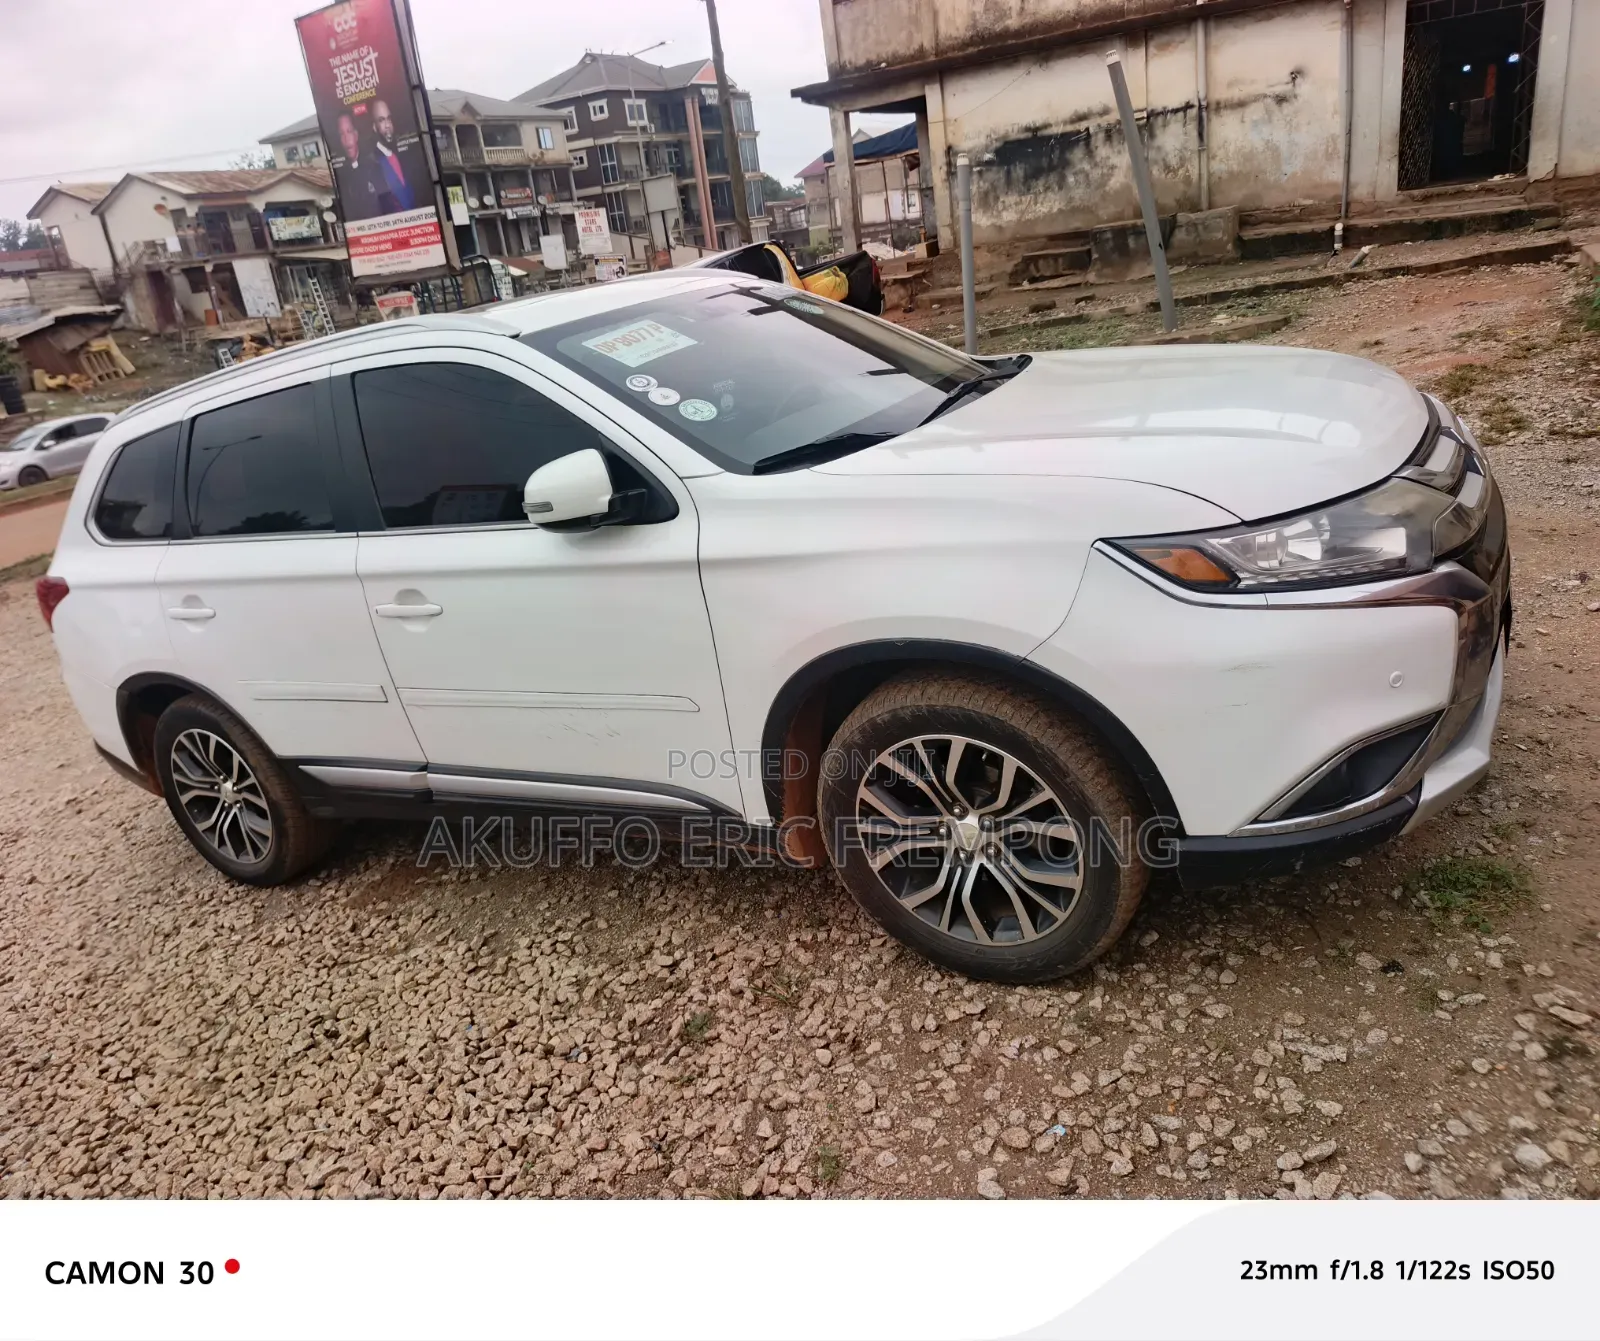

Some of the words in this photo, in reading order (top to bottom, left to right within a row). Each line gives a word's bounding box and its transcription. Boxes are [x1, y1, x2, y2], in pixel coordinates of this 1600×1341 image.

[328, 55, 342, 67] THE
[341, 49, 360, 64] NAME
[359, 45, 369, 57] OF
[335, 86, 344, 98] IS
[343, 75, 377, 96] ENOUGH
[343, 88, 377, 105] CONFERENCE
[404, 213, 424, 224] AUGUST
